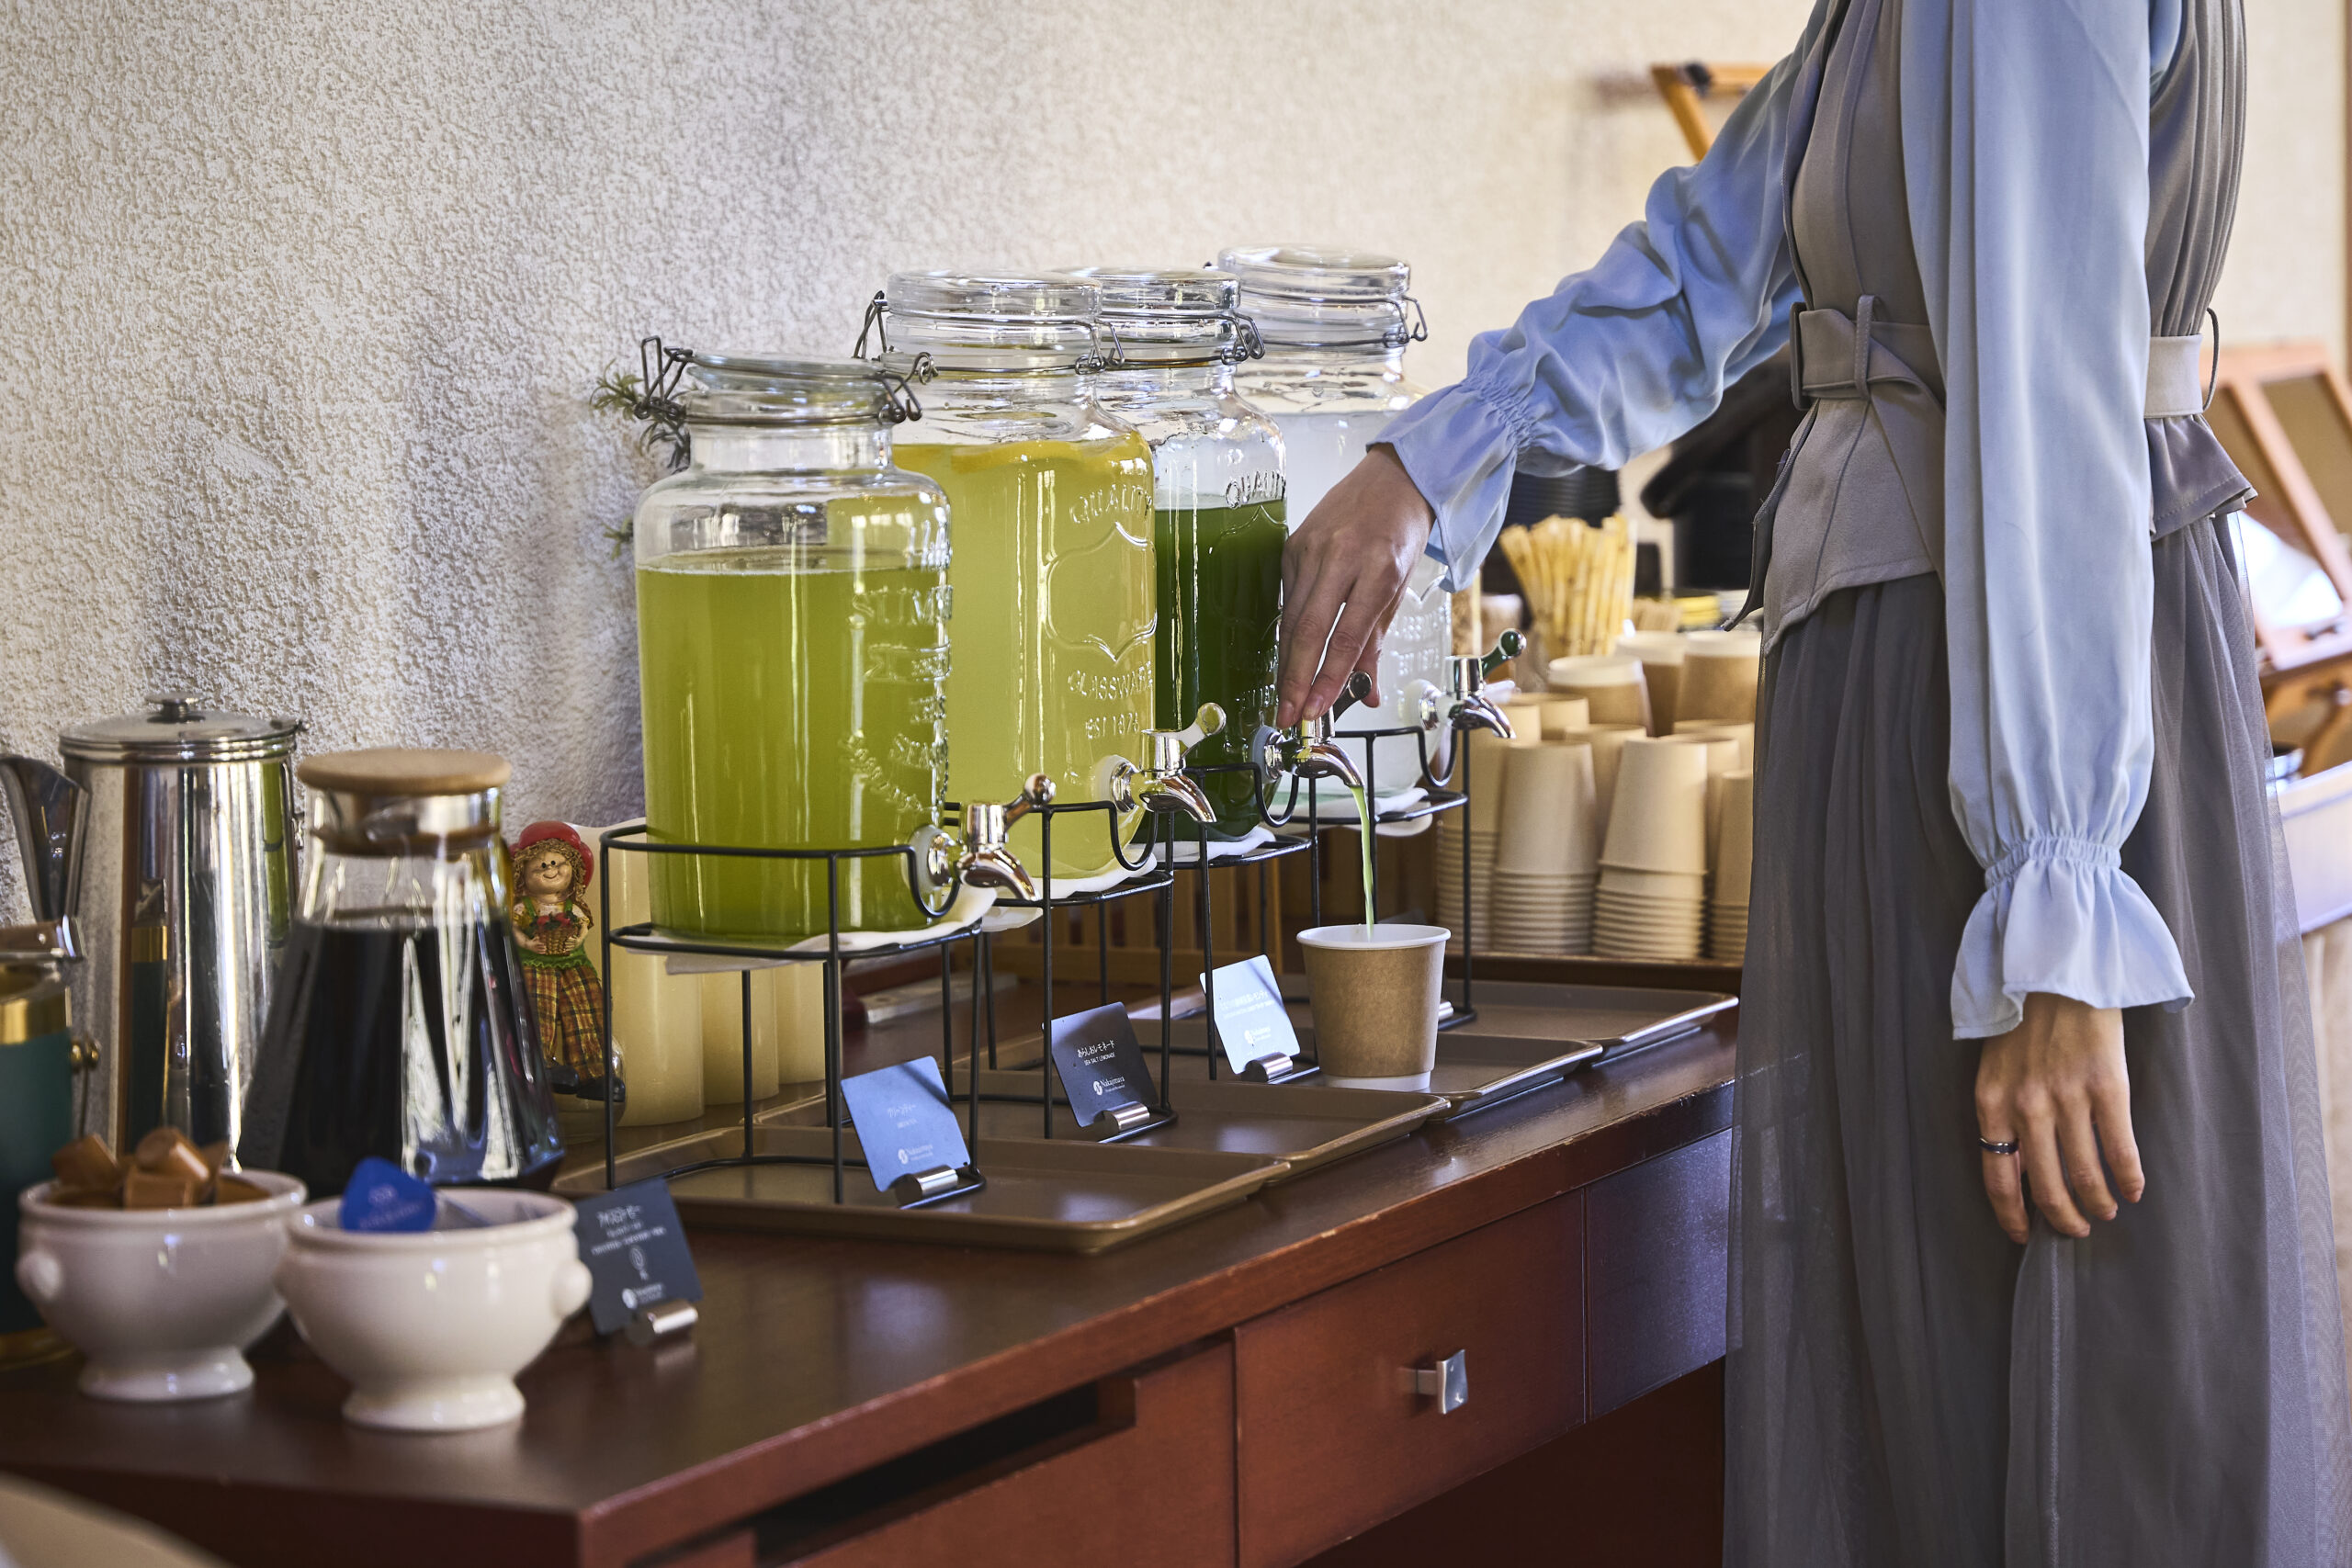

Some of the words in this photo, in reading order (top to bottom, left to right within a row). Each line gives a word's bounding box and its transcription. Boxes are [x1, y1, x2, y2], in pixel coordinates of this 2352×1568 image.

[1069, 483, 1153, 524] QUALITY
[1067, 660, 1153, 701] GLASSWARE
[1085, 716, 1106, 740] EST
[1077, 1040, 1115, 1058] あらしおレモネード
